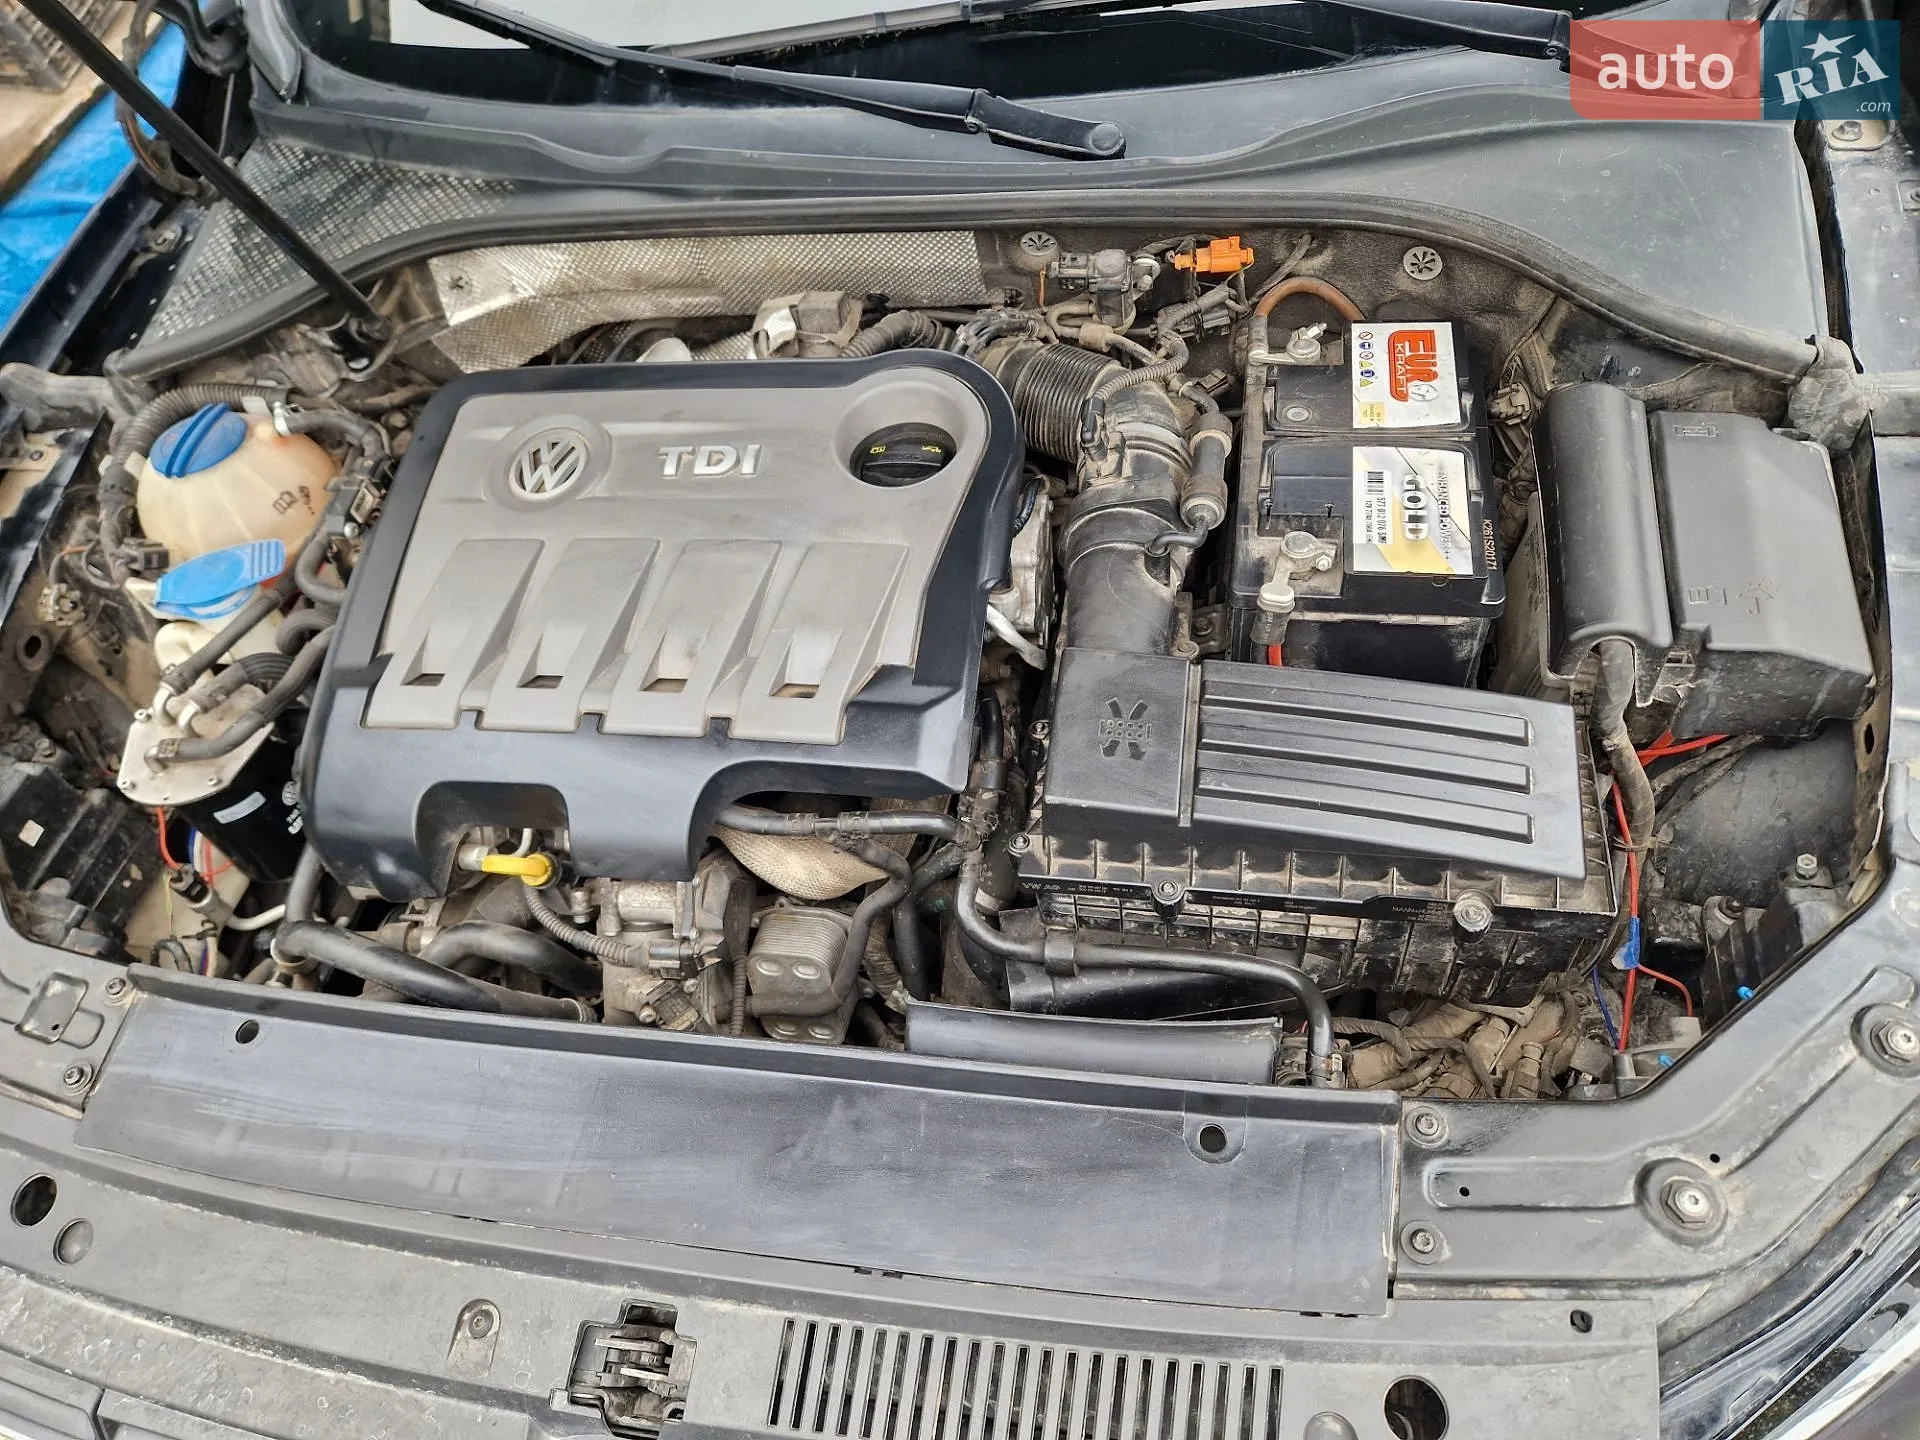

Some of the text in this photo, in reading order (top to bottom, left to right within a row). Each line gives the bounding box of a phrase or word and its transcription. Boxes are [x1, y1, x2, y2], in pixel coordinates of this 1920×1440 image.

[1394, 343, 1408, 394] KRAFT
[659, 444, 761, 479] TDI
[1376, 497, 1386, 507] 577
[1400, 474, 1430, 541] GOLD
[1378, 519, 1387, 530] 076
[1482, 519, 1498, 570] K261S20171
